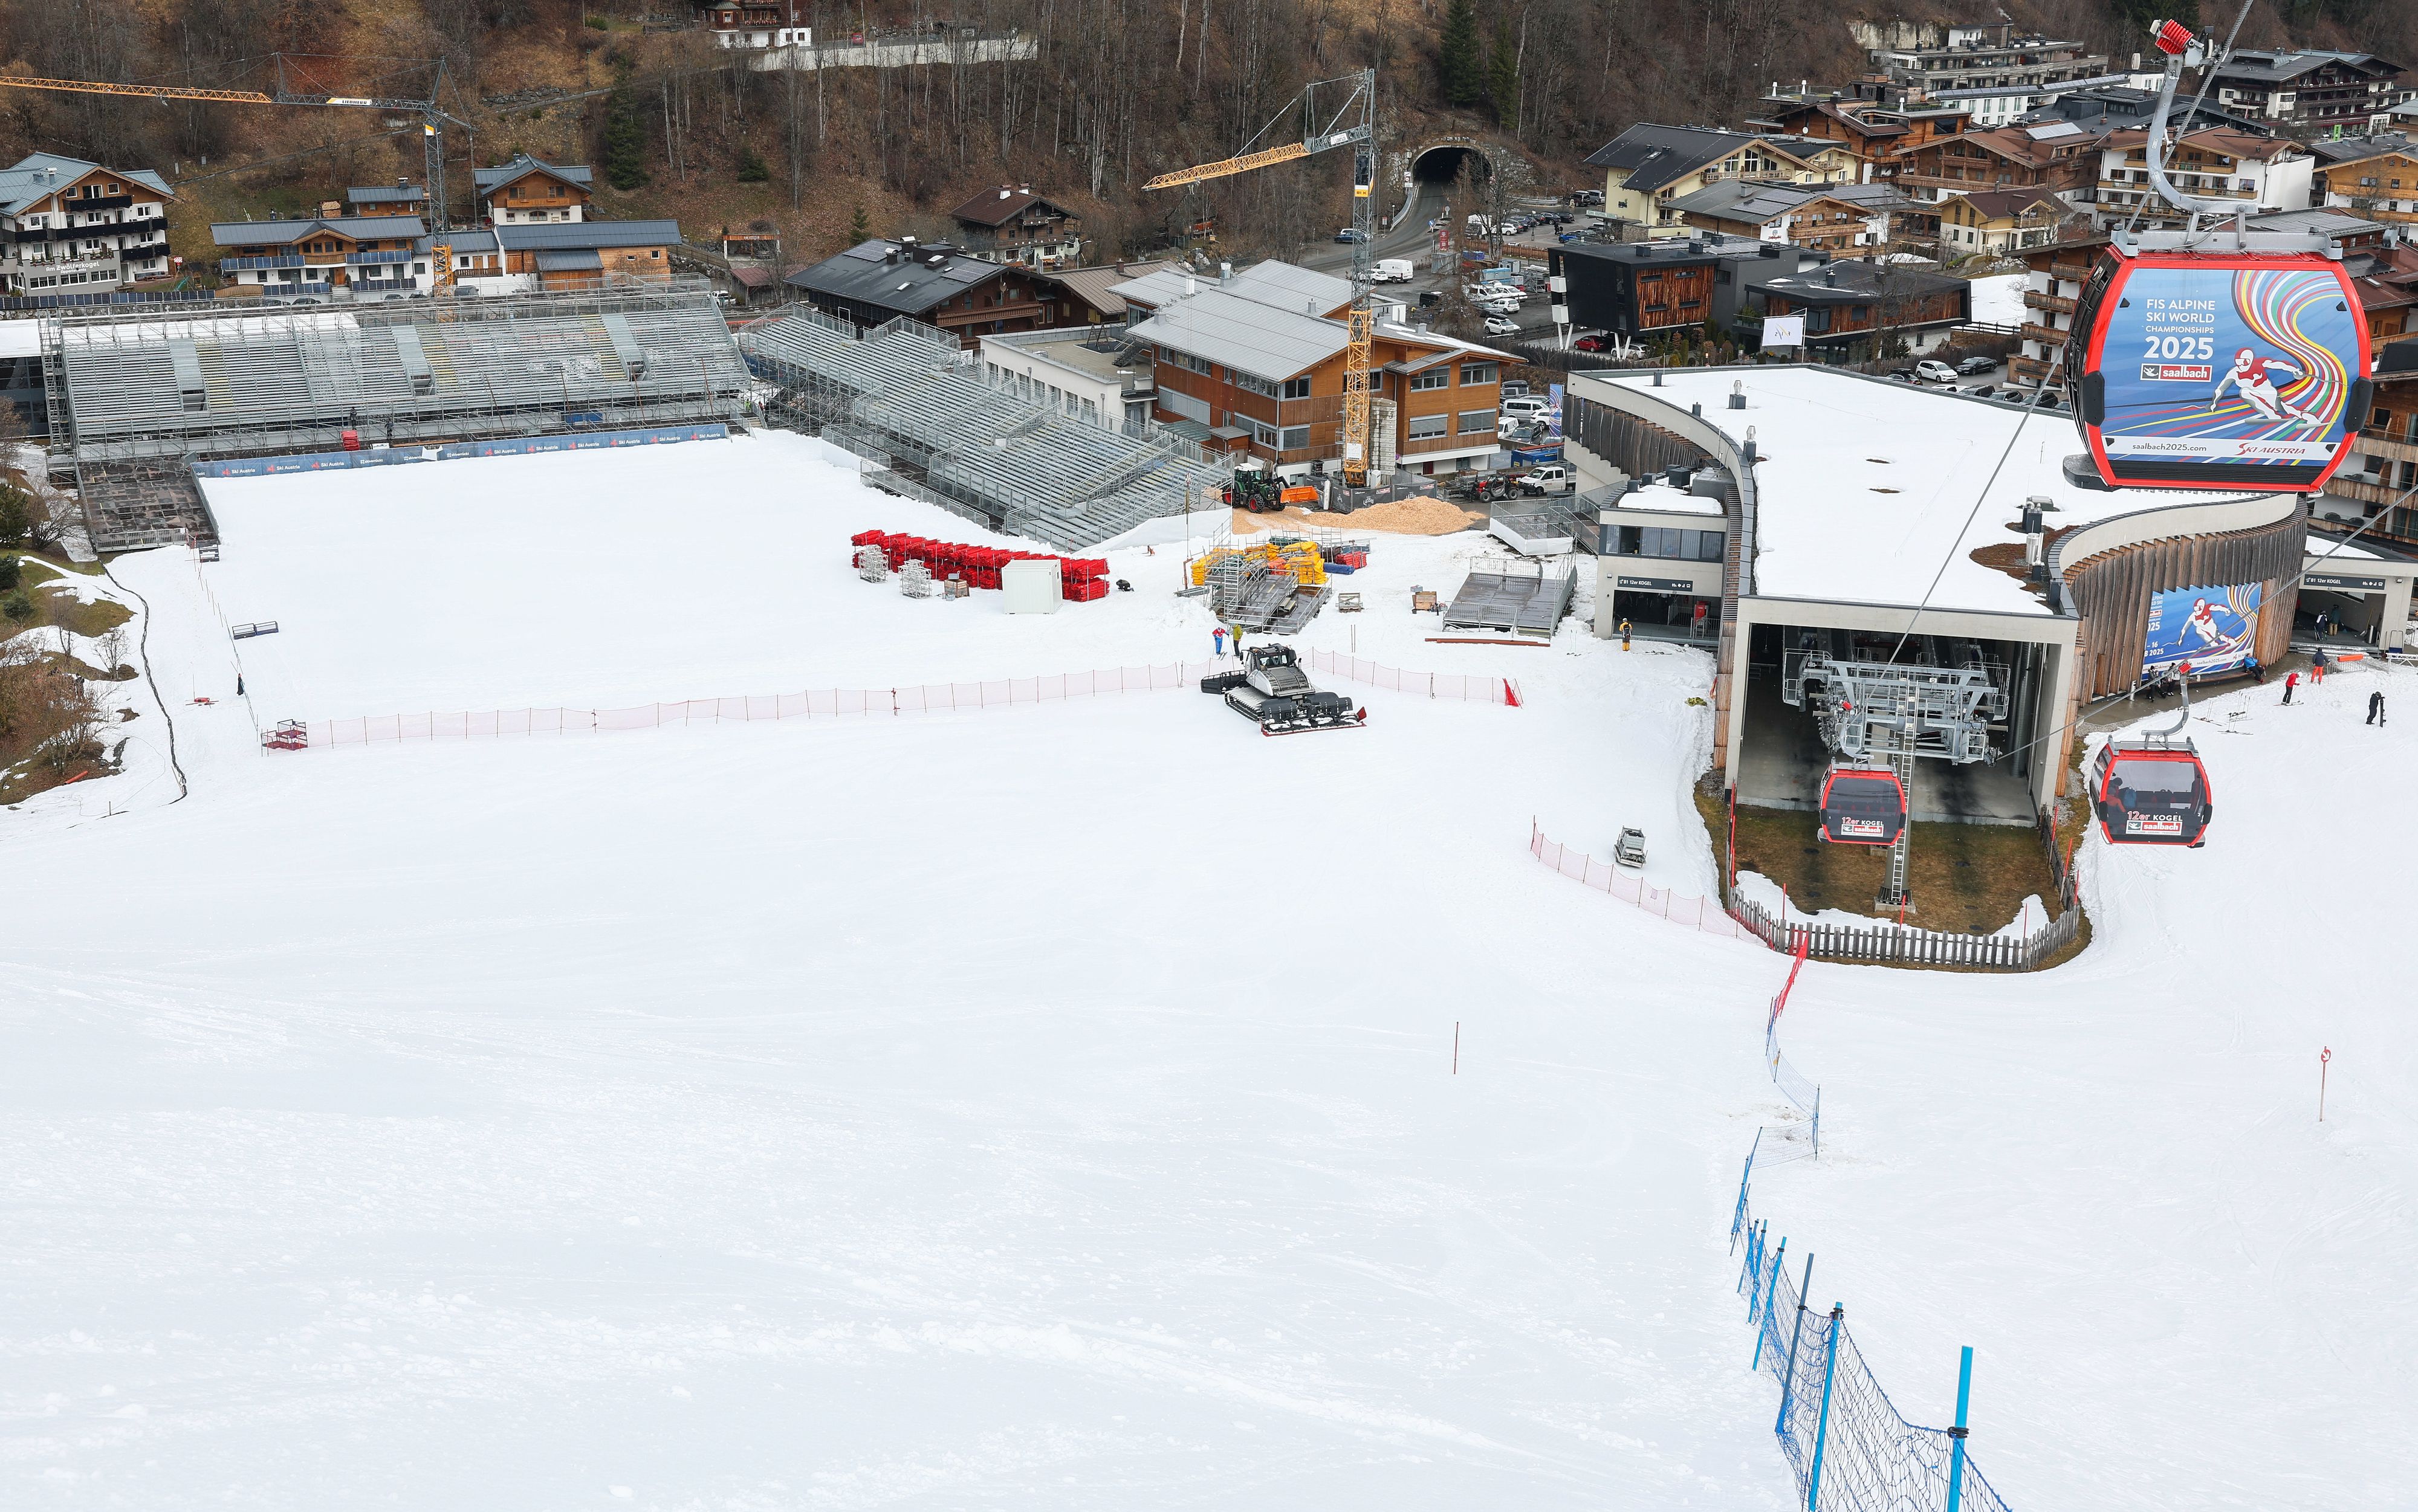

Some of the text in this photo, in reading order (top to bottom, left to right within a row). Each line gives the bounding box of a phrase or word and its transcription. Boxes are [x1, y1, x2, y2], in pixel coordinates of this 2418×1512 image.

[56, 261, 100, 270] Zwölferkogel
[2147, 299, 2215, 310] FIS ALPINE
[2146, 312, 2215, 323] SKI WORLD
[2145, 325, 2214, 334] CHAMPIONSHIPS
[2144, 335, 2214, 360] 2025
[2162, 366, 2208, 378] saalbach
[2132, 443, 2207, 452] saalbach2025.com
[2149, 648, 2164, 656] 2025
[2127, 810, 2150, 821] 12er
[2143, 822, 2179, 830] saalbach
